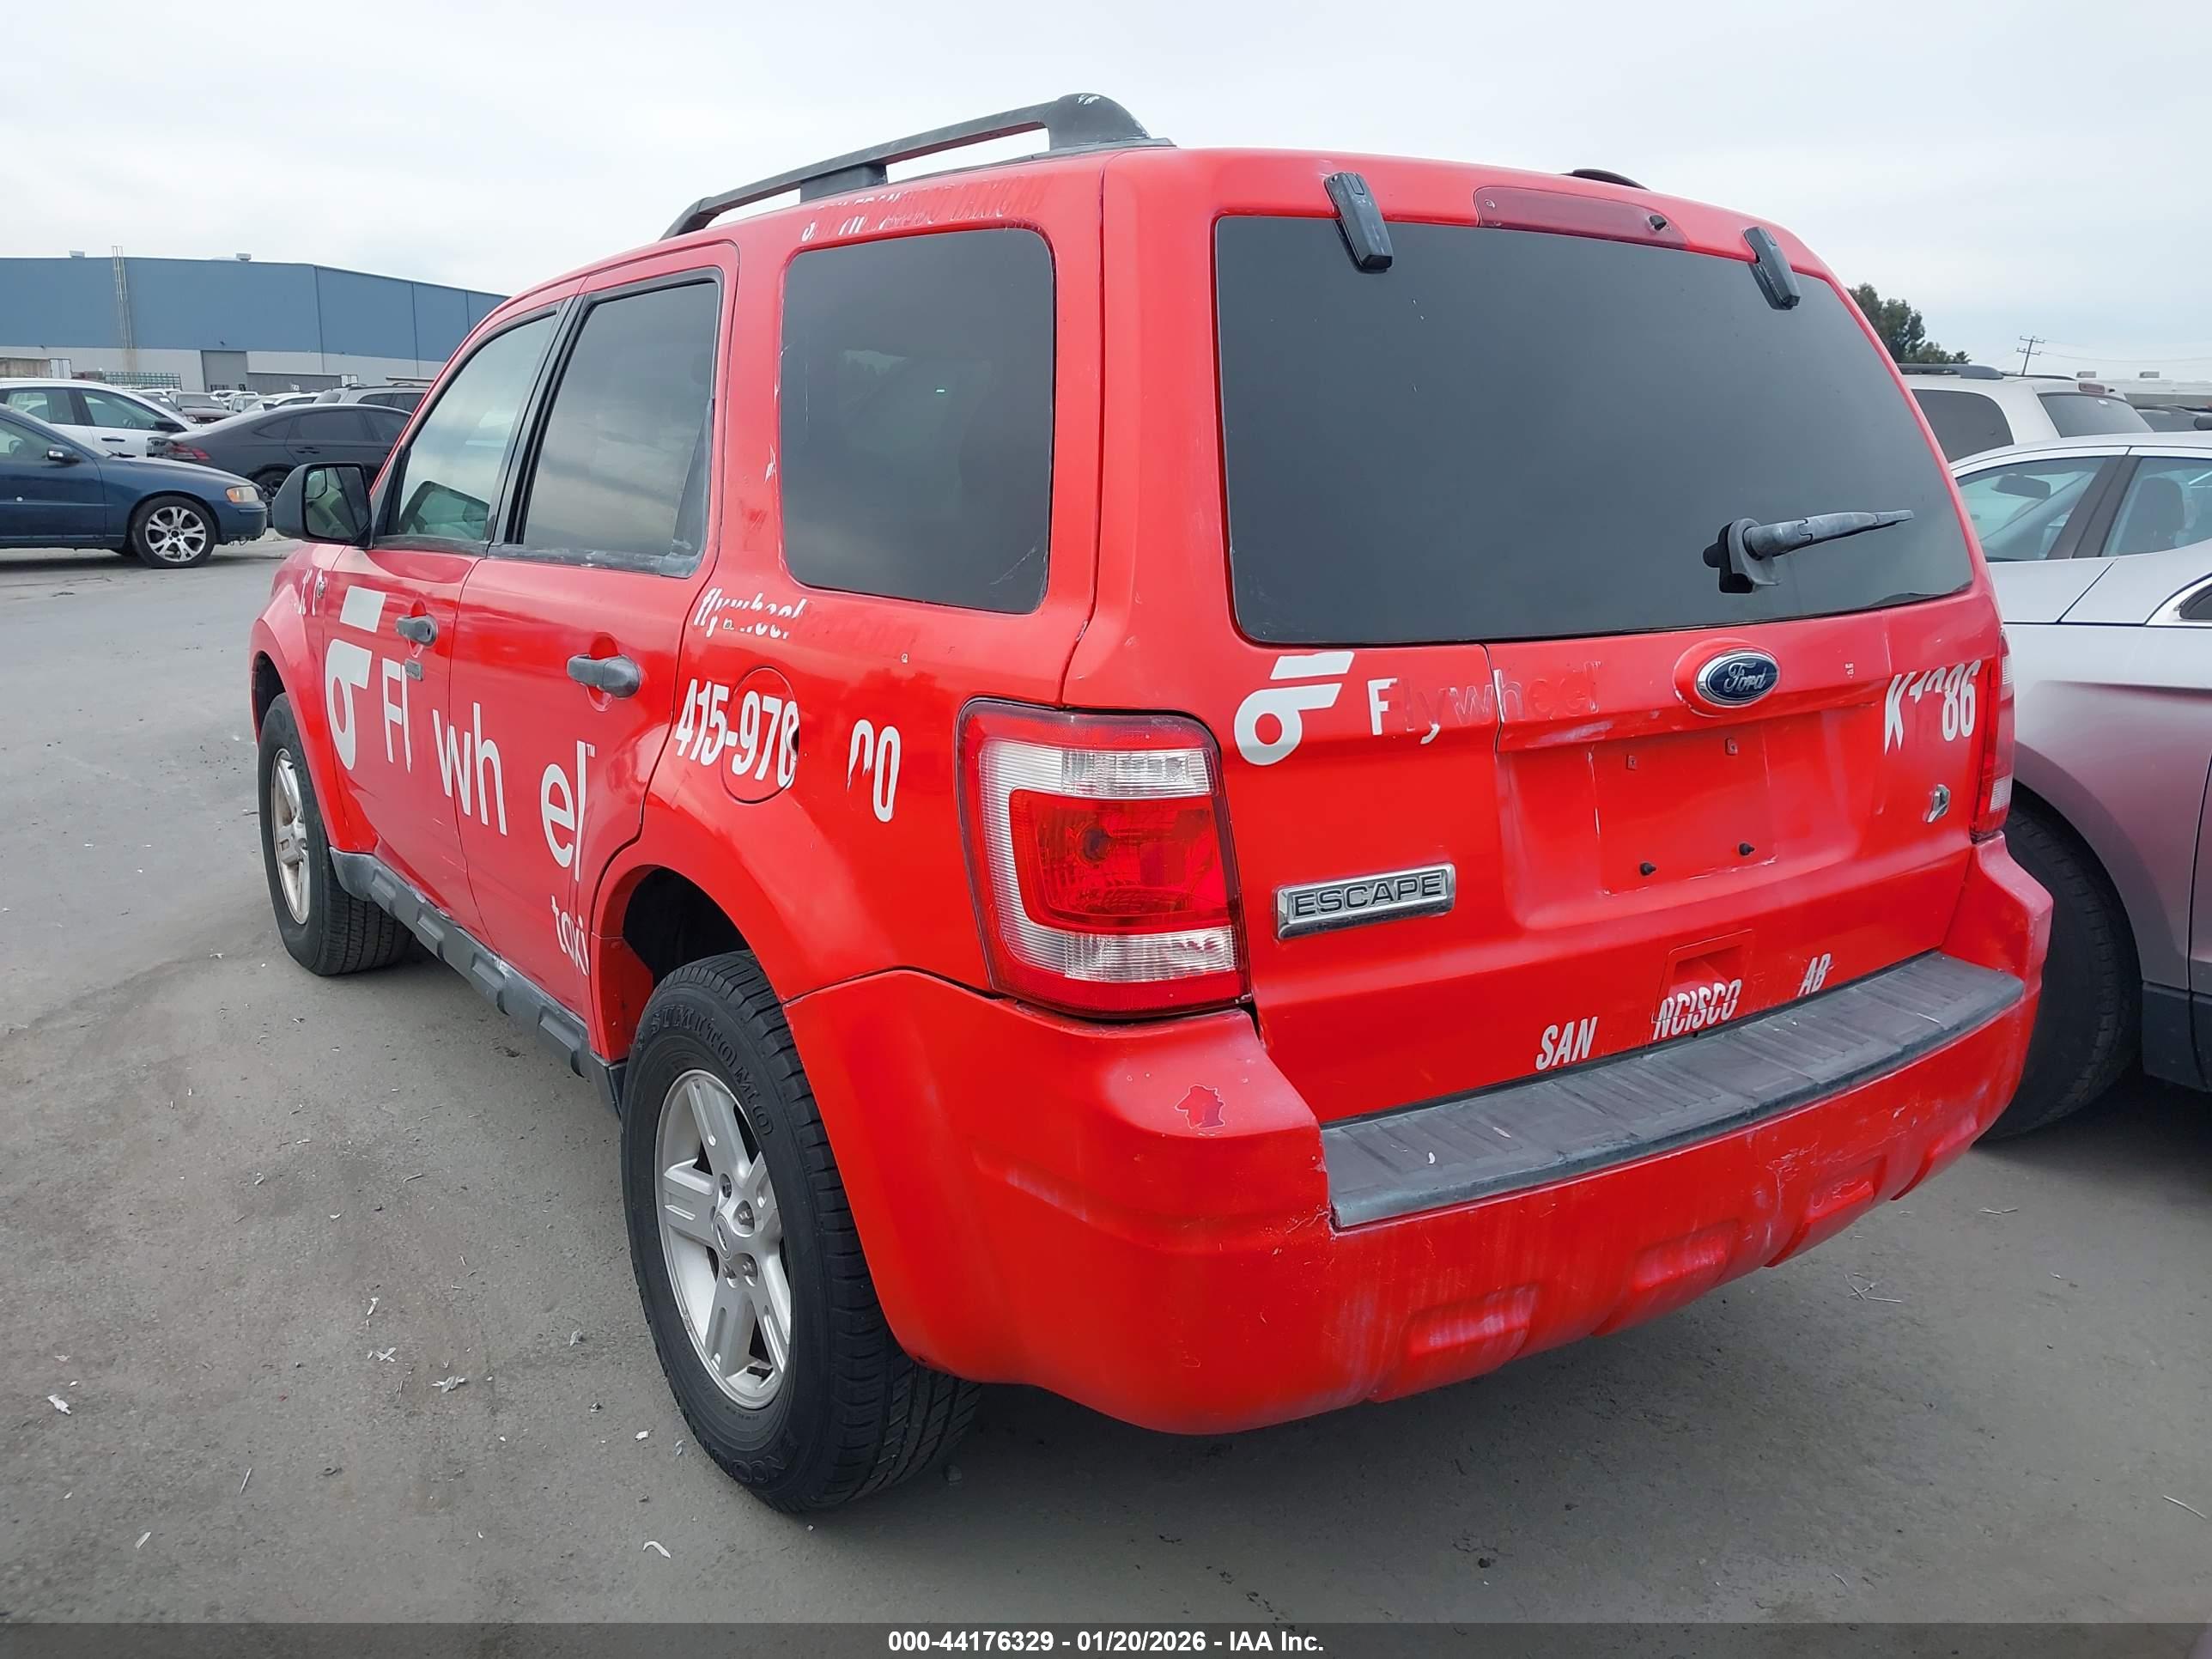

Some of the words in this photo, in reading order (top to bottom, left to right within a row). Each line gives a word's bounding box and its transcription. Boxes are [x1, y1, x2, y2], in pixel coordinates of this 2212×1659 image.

[1723, 661, 1767, 693] Ford
[1292, 871, 1443, 918] ESCAPE
[1535, 1016, 1598, 1071] SAN
